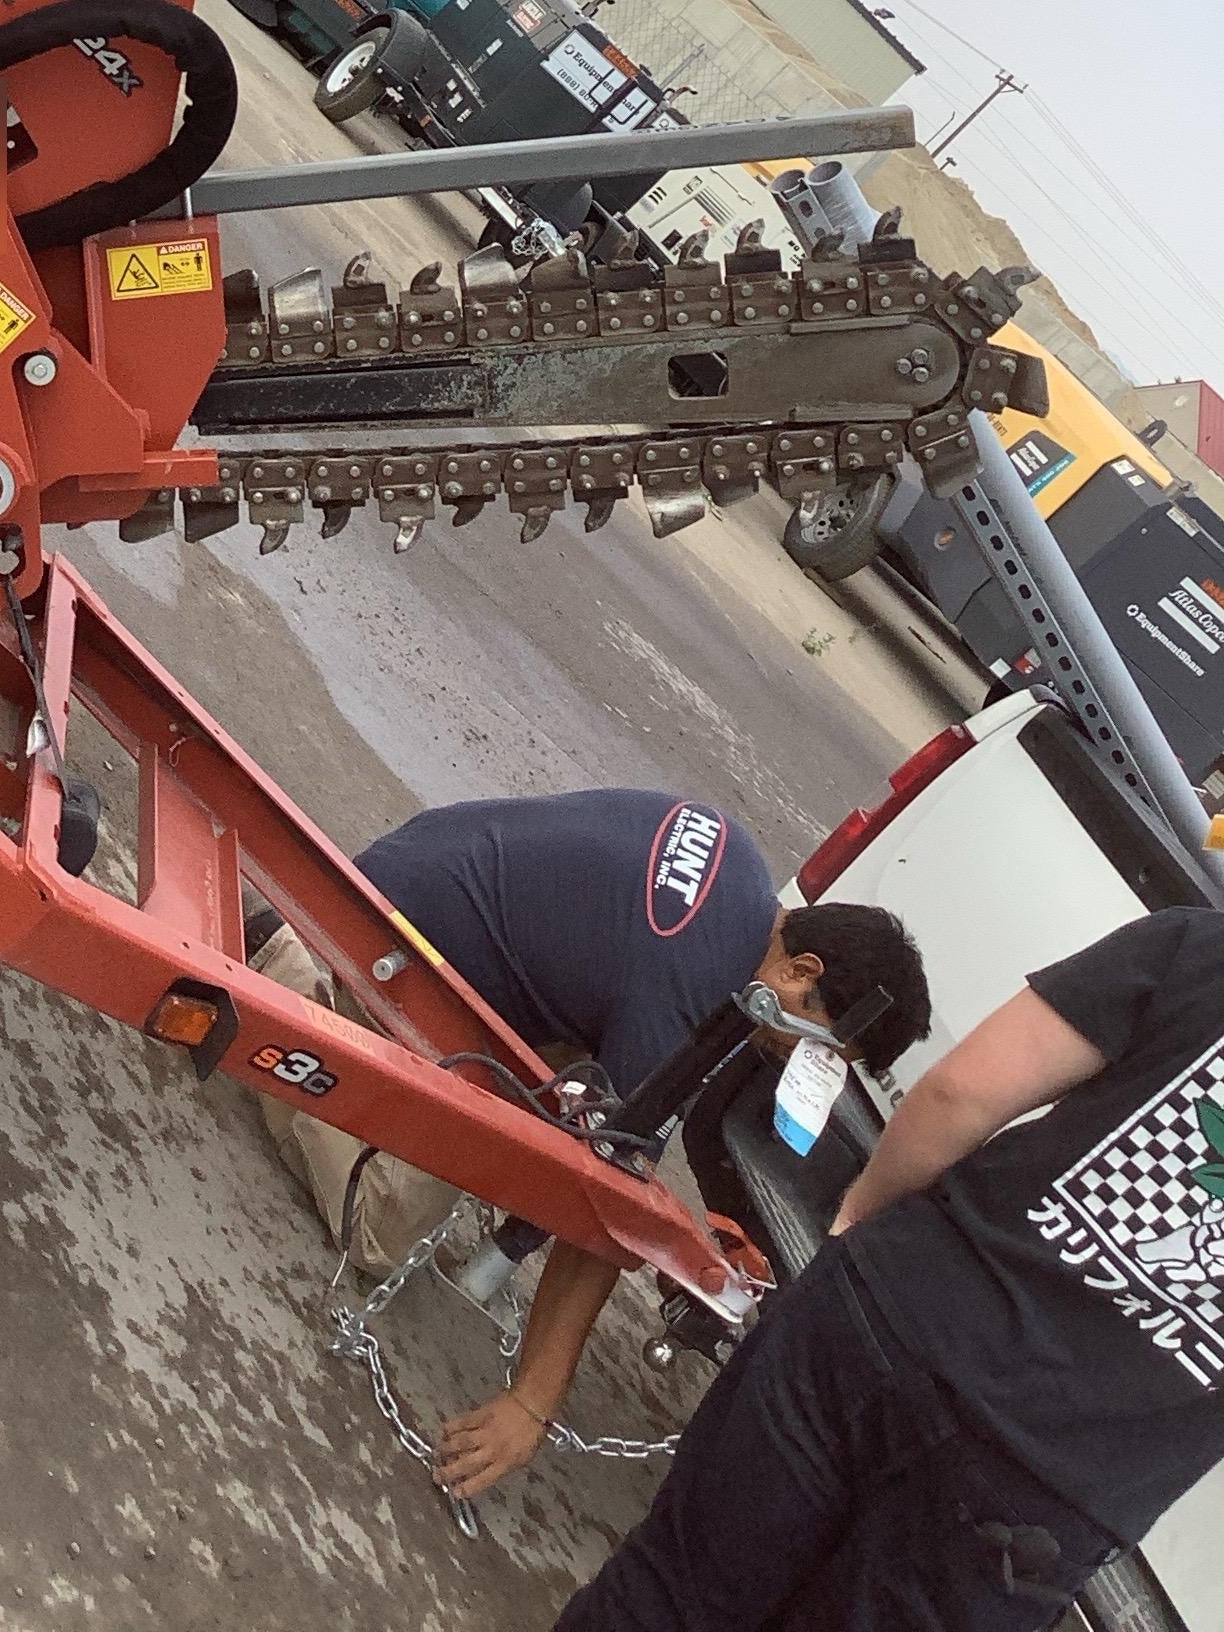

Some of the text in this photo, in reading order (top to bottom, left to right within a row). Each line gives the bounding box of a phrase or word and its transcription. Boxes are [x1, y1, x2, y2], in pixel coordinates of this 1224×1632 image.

[168, 242, 203, 254] DANGER
[0, 291, 29, 321] DANGER
[1135, 613, 1205, 677] EquipmentShare
[667, 811, 721, 907] HUNT
[654, 860, 671, 889] INC.
